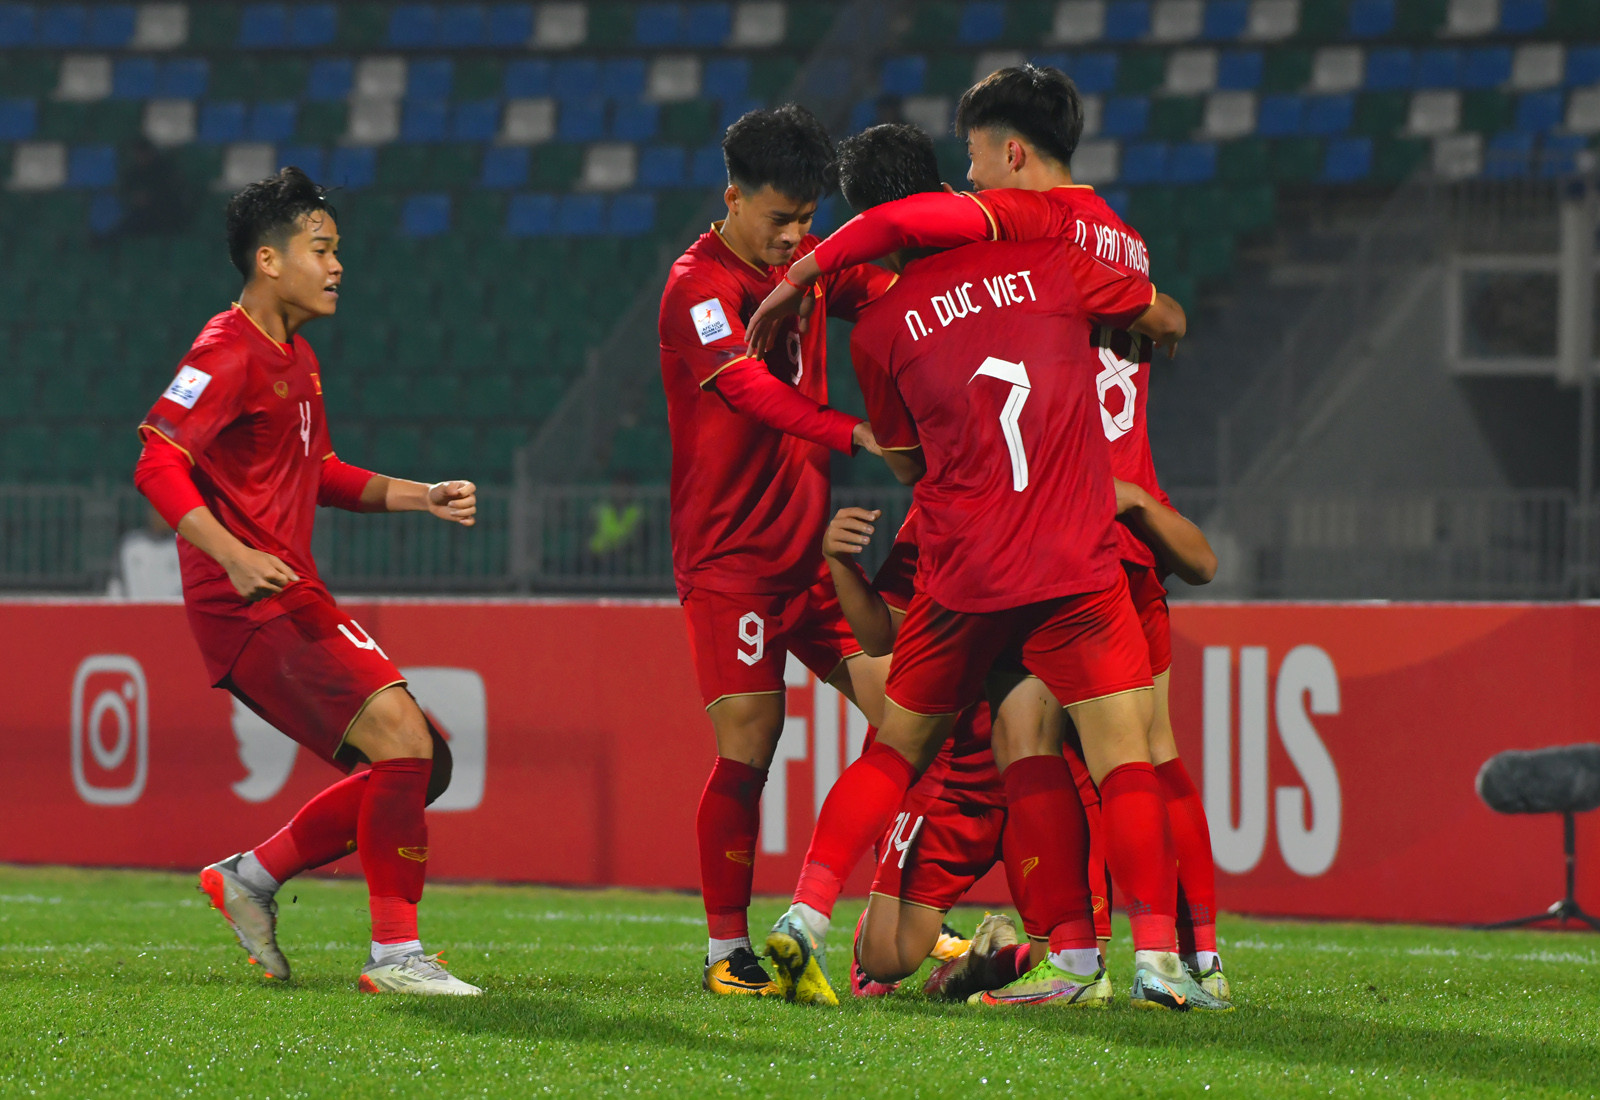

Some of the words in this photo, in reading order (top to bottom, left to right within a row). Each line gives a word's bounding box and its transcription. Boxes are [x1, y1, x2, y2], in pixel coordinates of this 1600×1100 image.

[1093, 222, 1120, 263] VAN
[904, 310, 933, 341] N.
[930, 281, 982, 327] DUC
[982, 270, 1036, 308] VIET
[1096, 326, 1141, 442] 8
[299, 400, 311, 457] 4
[967, 356, 1031, 492] 7
[337, 619, 389, 660] 4
[737, 611, 764, 666] 9
[1203, 644, 1341, 877] US
[881, 811, 924, 869] 14
